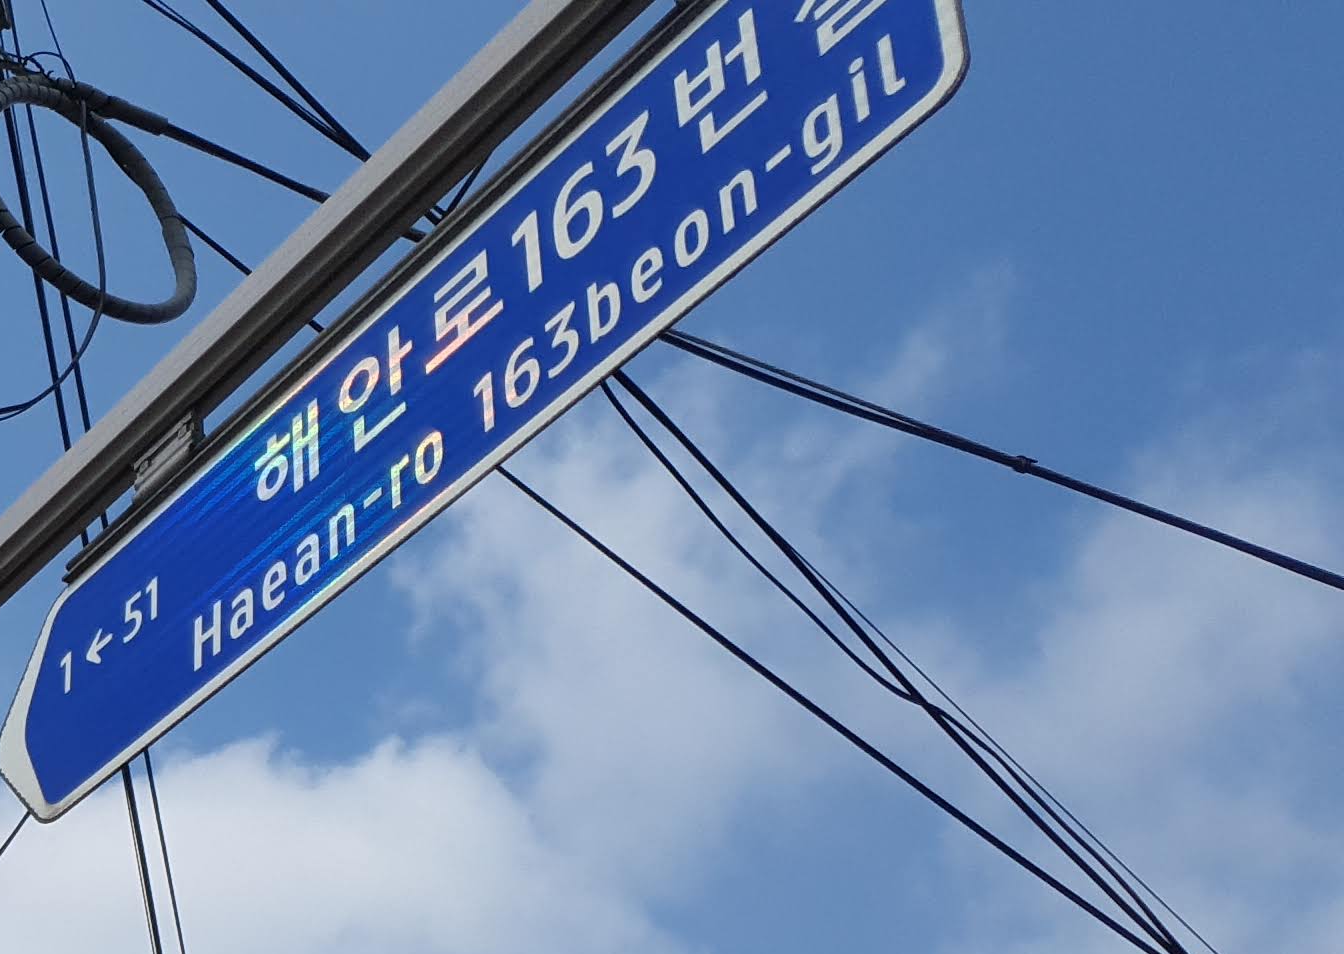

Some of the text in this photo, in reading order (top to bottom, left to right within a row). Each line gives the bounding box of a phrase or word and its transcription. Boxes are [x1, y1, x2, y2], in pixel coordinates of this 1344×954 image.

[193, 34, 907, 672] Haean-ro 163beon-gil
[60, 576, 159, 694] 1 51
